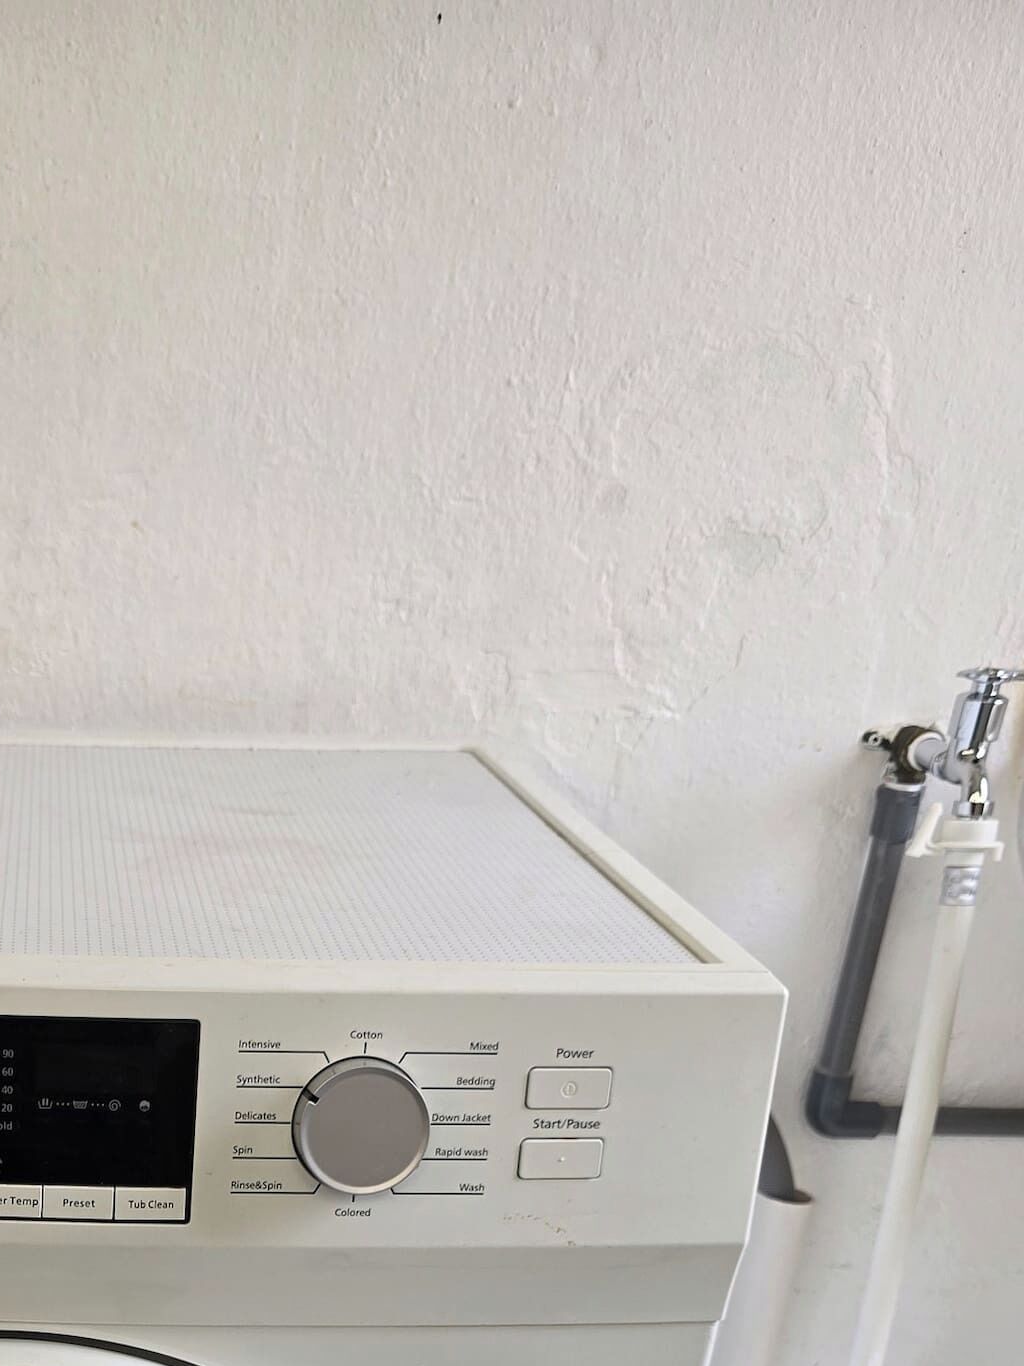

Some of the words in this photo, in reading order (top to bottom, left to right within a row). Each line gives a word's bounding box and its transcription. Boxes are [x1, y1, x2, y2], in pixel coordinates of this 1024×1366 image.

[350, 1030, 383, 1040] Cotton
[238, 1040, 281, 1049] Intensive
[469, 1042, 499, 1051] Mixed
[2, 1049, 14, 1058] 90
[556, 1048, 594, 1059] Power
[1, 1067, 14, 1077] 60
[236, 1075, 281, 1086] Synthetic
[456, 1077, 496, 1087] Bedding
[1, 1085, 14, 1094] 40
[1, 1103, 13, 1112] 20
[234, 1111, 277, 1121] Delicates
[431, 1113, 460, 1122] Down
[462, 1113, 491, 1122] Jacket
[532, 1118, 601, 1130] Start/Pause
[232, 1146, 253, 1155] Spin
[435, 1148, 462, 1157] Rapid
[231, 1181, 283, 1191] Rinse&Spin
[459, 1184, 485, 1193] Wash
[10, 1197, 40, 1208] Temp
[62, 1198, 96, 1208] Preset
[128, 1200, 146, 1209] Tub
[148, 1200, 175, 1209] Clean
[334, 1208, 372, 1218] Colored
